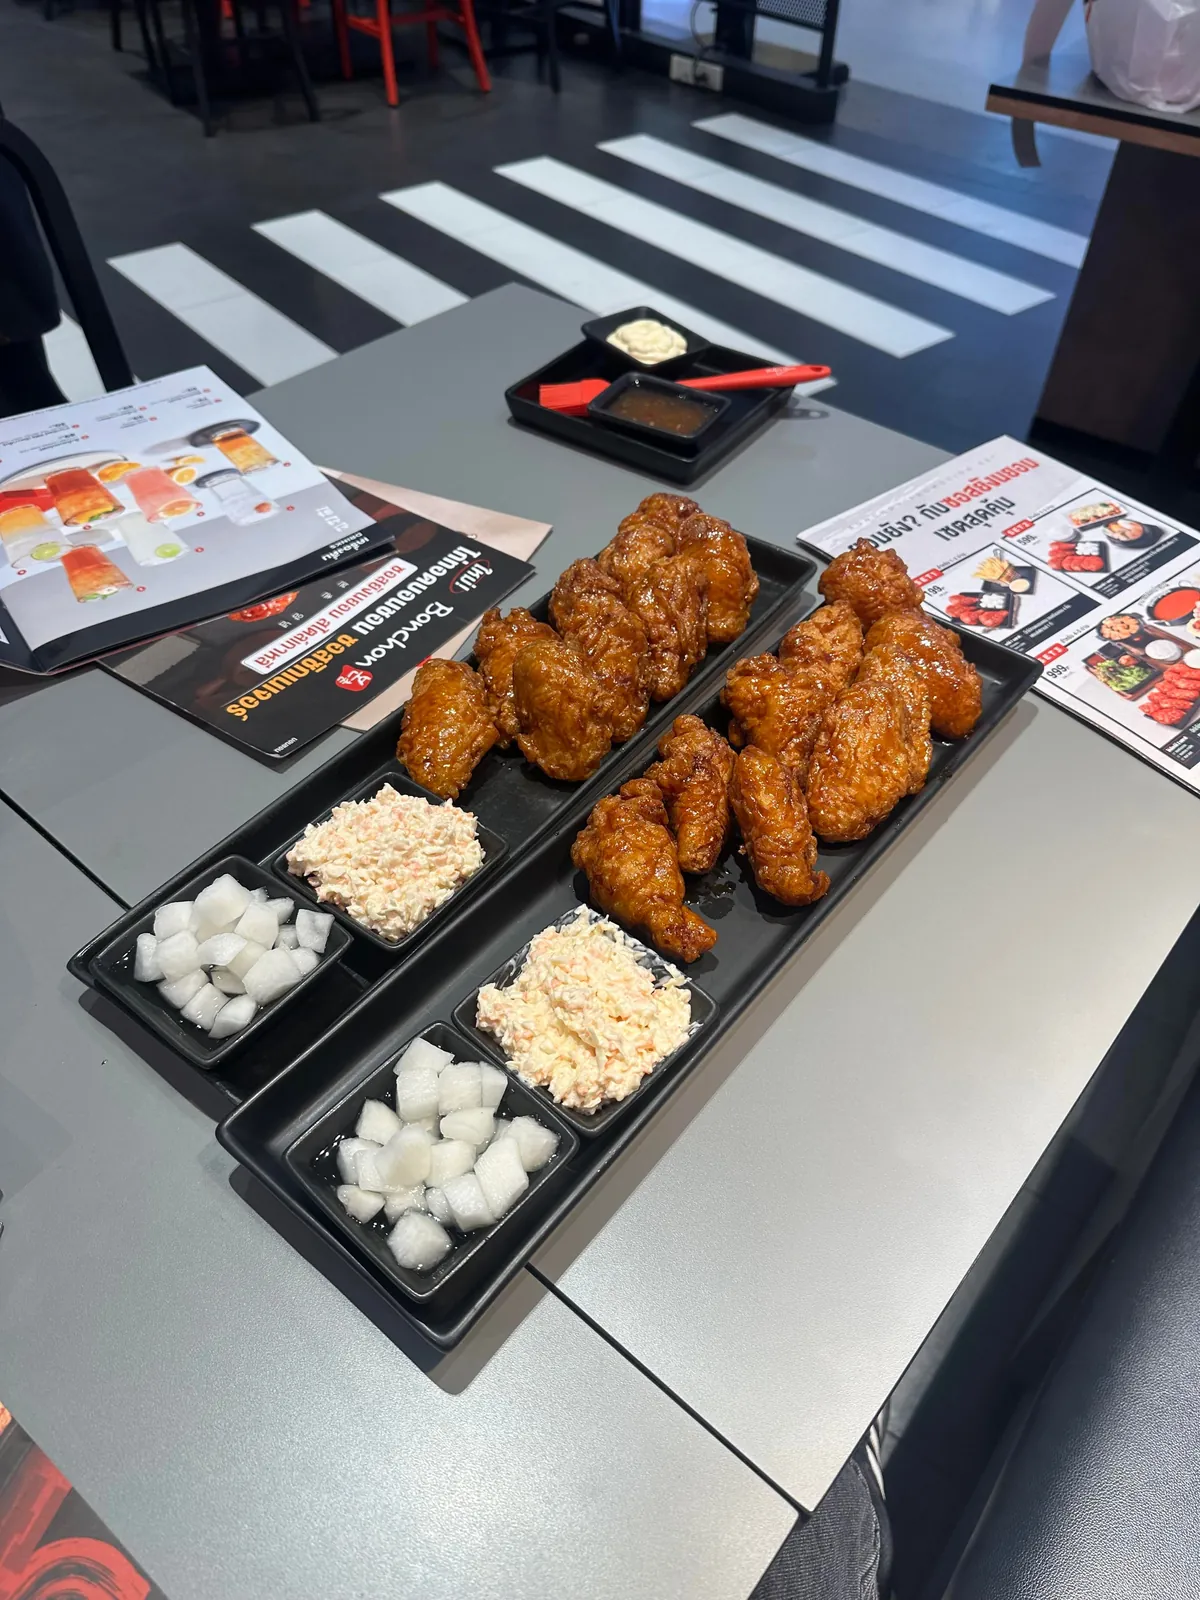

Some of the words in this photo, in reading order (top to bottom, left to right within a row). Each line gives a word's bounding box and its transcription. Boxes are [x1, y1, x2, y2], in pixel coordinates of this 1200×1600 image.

[329, 532, 363, 549] DRINKS
[933, 496, 1016, 541] เซตสุดคุ้ม
[321, 537, 370, 561] เครื่องดื่ม
[328, 564, 406, 619] ซอสยังนยอม
[351, 545, 482, 636] ไก่ทอดบอนชอน
[454, 563, 493, 592] ใหม่!
[254, 617, 331, 669] สไตล์เกาหลี
[355, 601, 454, 667] Bonchon
[226, 633, 359, 721] ซอสซิกเนเจอร์
